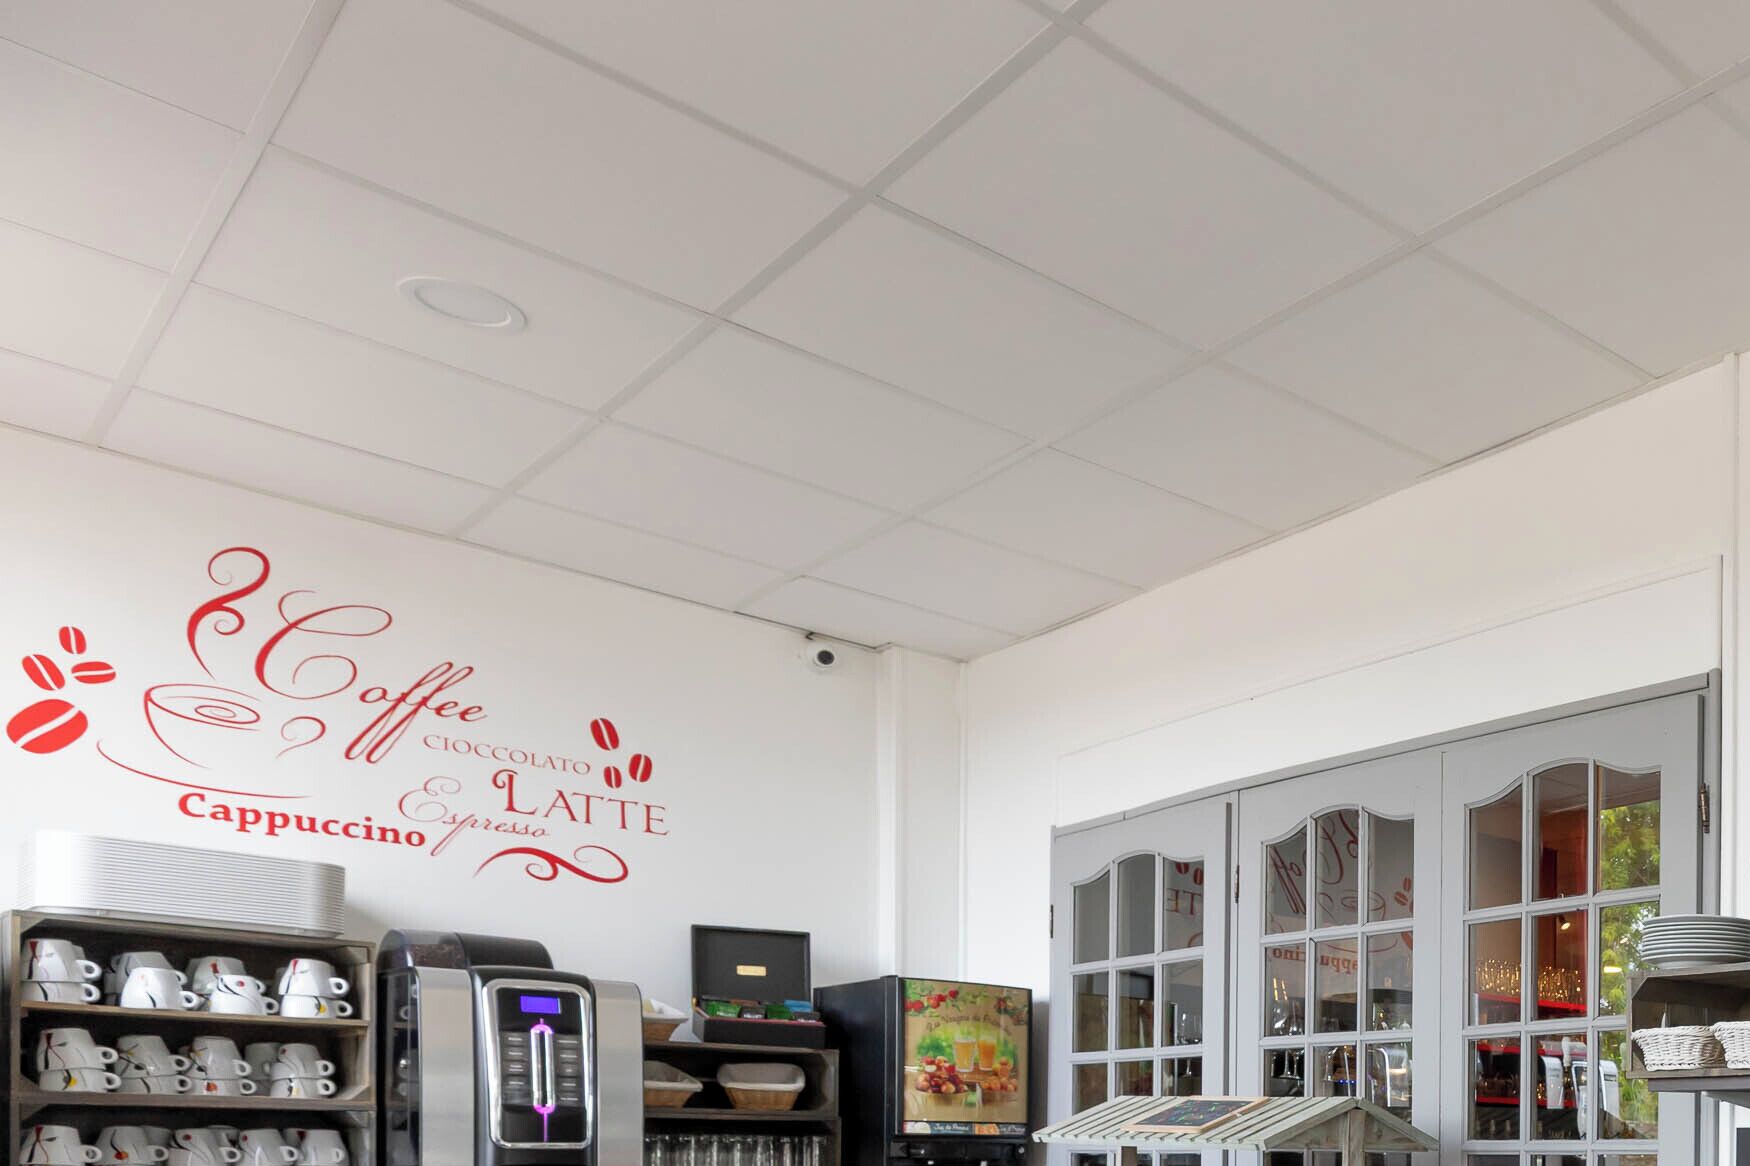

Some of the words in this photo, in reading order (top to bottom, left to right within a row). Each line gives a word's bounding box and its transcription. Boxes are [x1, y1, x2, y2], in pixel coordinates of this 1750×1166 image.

[254, 590, 487, 765] Coffee
[422, 734, 592, 776] CIOCCOLATO
[177, 790, 426, 848] Cappuccino
[398, 776, 550, 857] Espresso
[491, 768, 670, 837] LATTE
